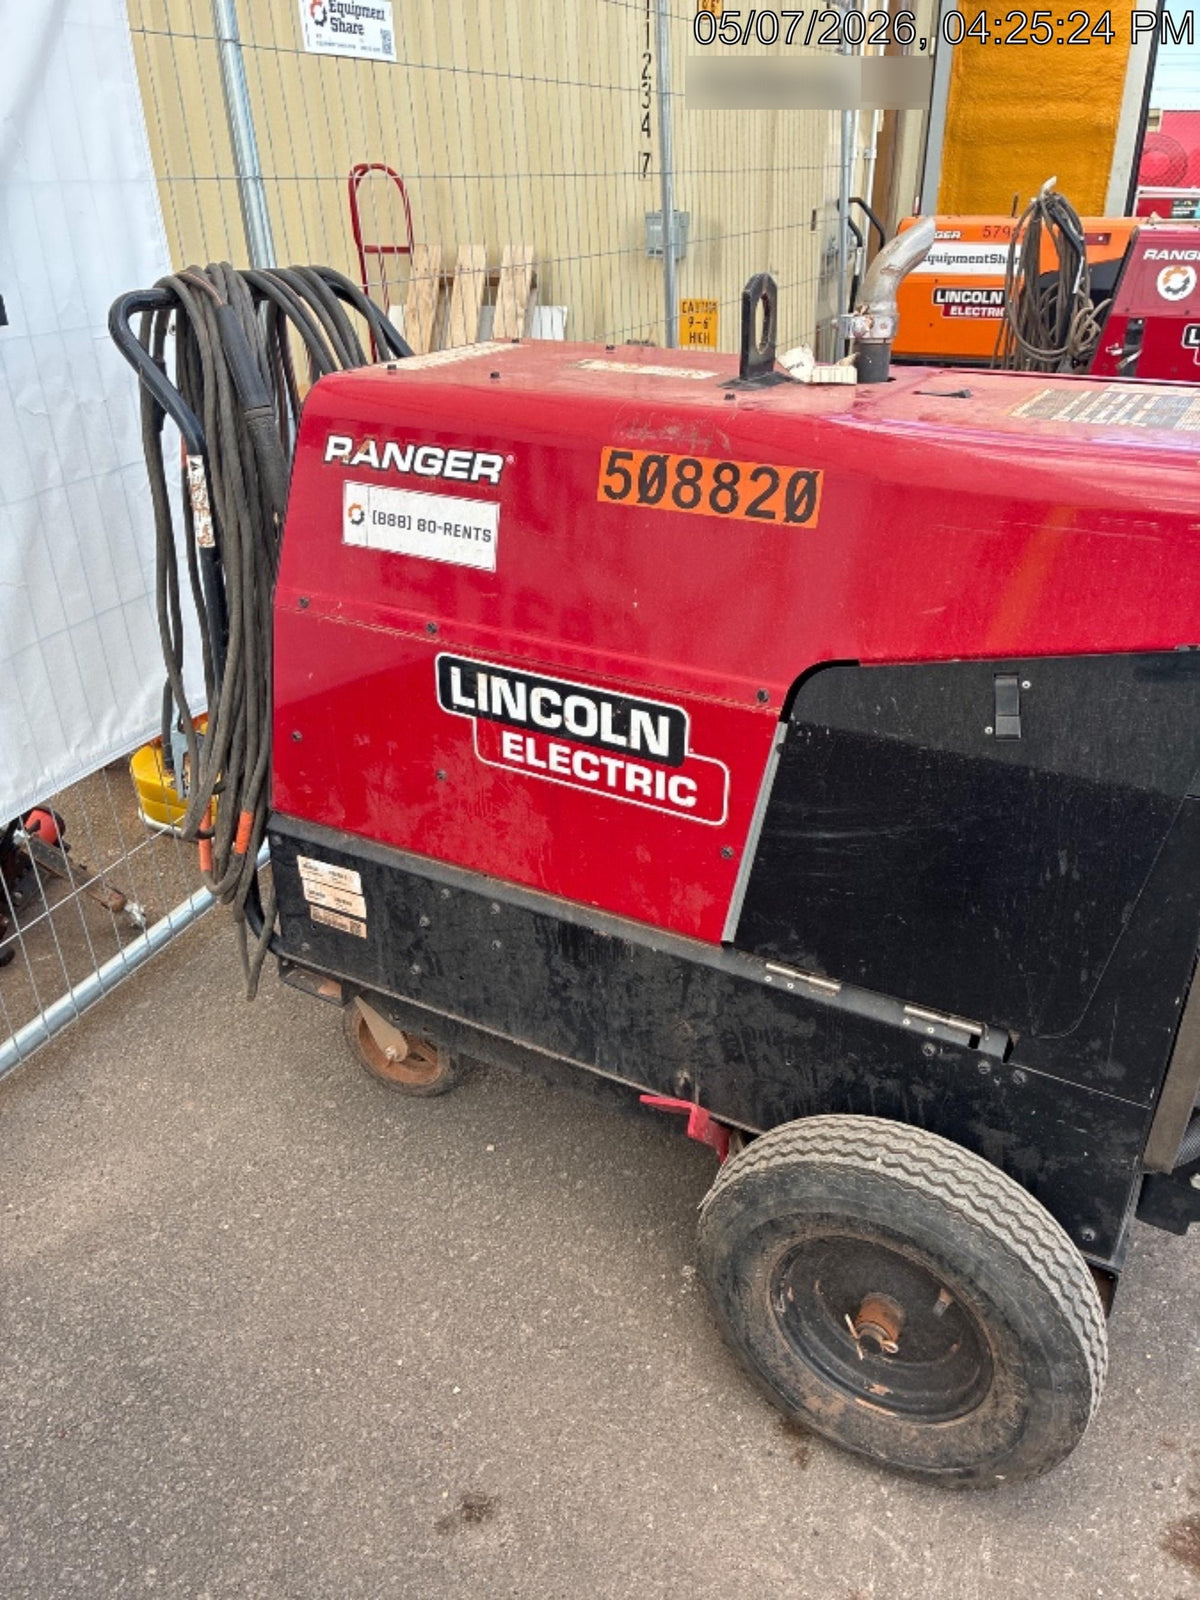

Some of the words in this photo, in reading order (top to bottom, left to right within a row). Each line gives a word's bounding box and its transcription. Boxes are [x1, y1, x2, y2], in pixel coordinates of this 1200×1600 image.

[329, 0, 386, 21] Equipment
[330, 17, 364, 35] Share
[936, 290, 1004, 305] LINCOLN
[602, 449, 820, 524] 508820
[417, 518, 492, 543] 80-RENTS
[450, 666, 670, 757] LINCOLN
[501, 730, 698, 808] ELECTRIC
